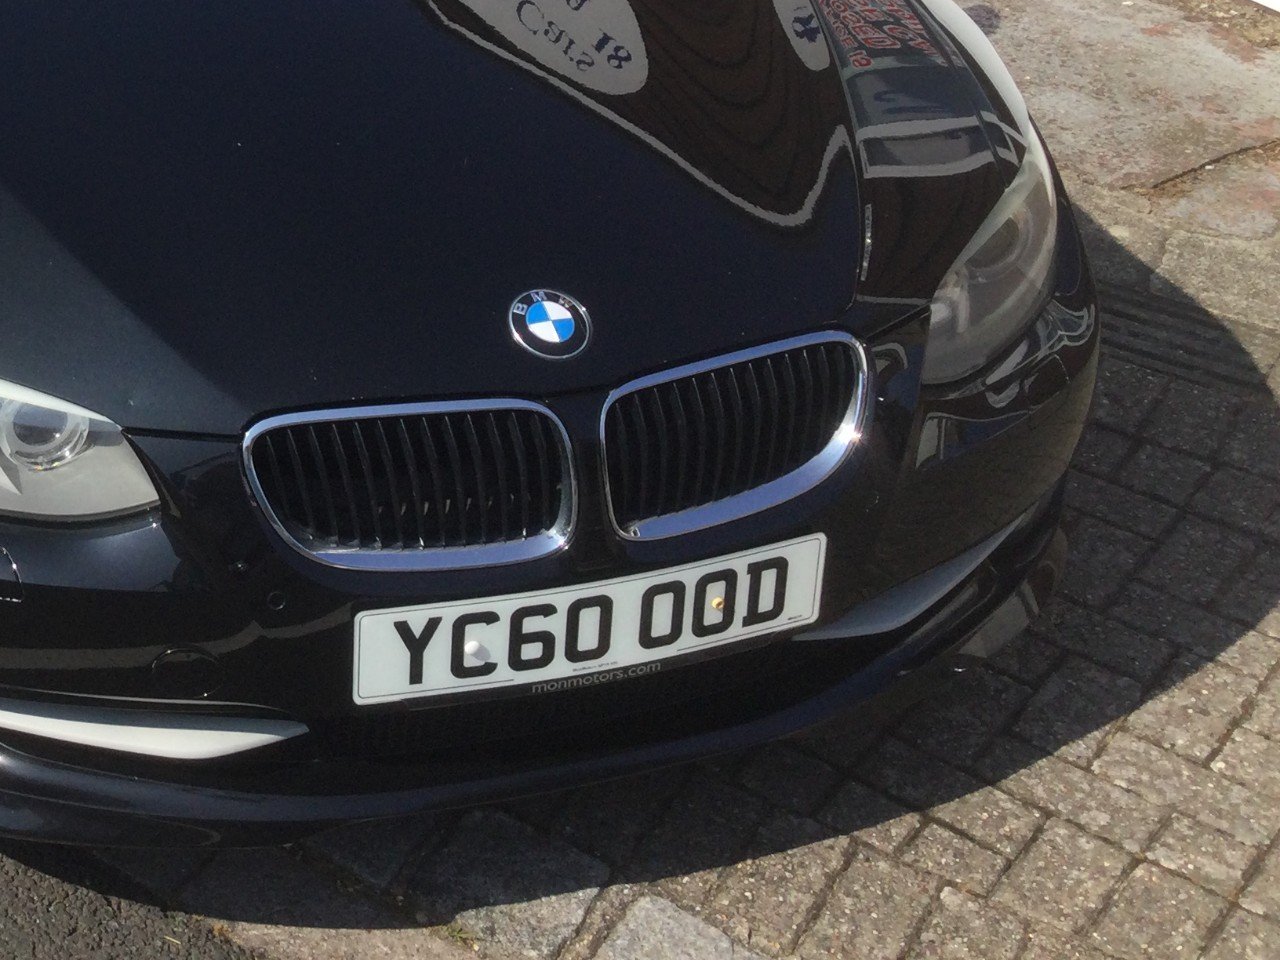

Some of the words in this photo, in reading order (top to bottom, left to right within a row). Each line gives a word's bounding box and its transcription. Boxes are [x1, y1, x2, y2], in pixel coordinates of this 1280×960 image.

[513, 291, 573, 316] BMW
[393, 595, 613, 685] YC60
[532, 662, 661, 693] monmotors.com
